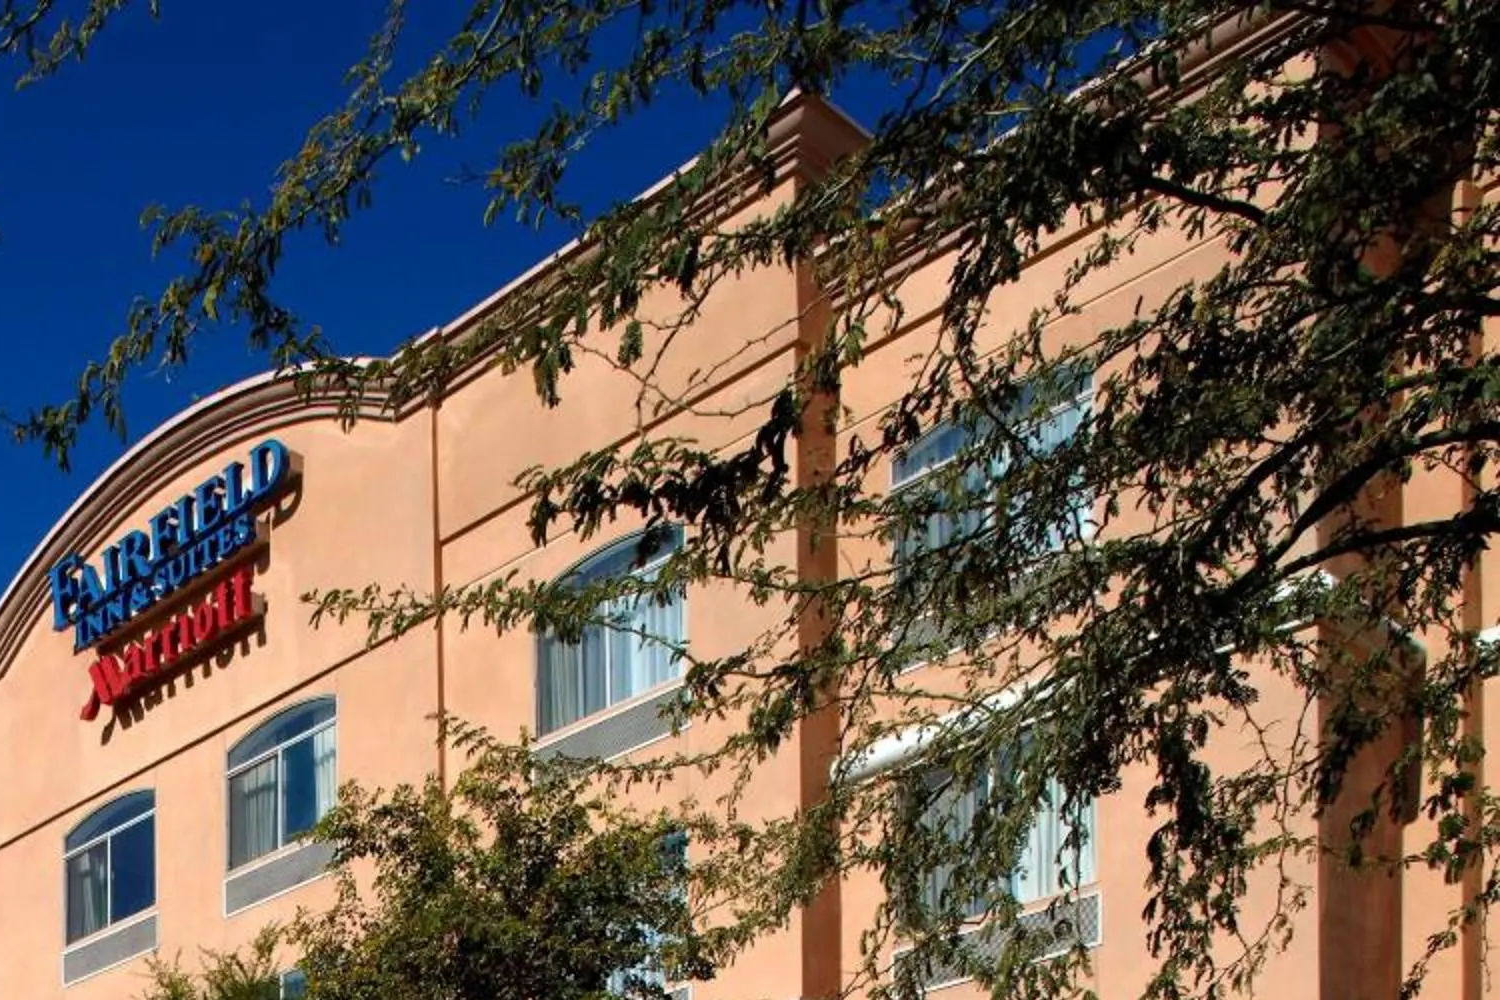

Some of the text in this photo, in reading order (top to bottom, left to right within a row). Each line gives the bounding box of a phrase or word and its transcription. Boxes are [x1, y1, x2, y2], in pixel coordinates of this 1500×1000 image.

[49, 438, 291, 632] FAIRFIELD
[74, 589, 132, 651] INN
[155, 513, 257, 595] SUITES
[80, 564, 255, 721] Marriott
